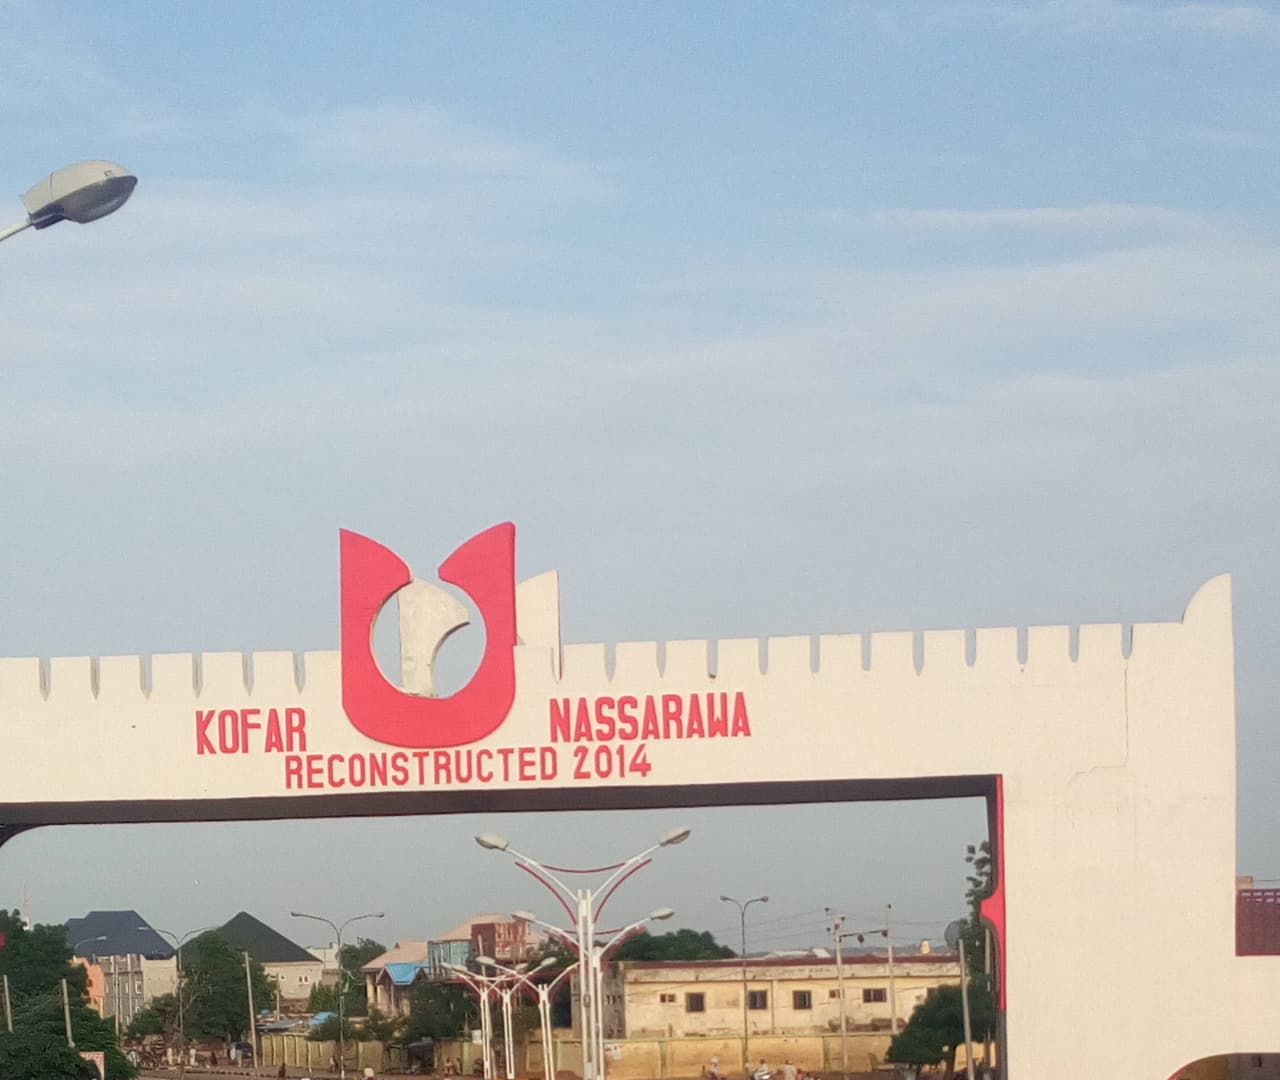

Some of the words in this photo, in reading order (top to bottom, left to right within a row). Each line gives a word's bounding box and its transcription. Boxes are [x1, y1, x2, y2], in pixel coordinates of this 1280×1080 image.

[196, 707, 308, 755] KOFAR
[549, 691, 752, 743] NASSARAWA
[284, 745, 559, 790] RECONSTRUCTED
[574, 744, 653, 780] 2014
